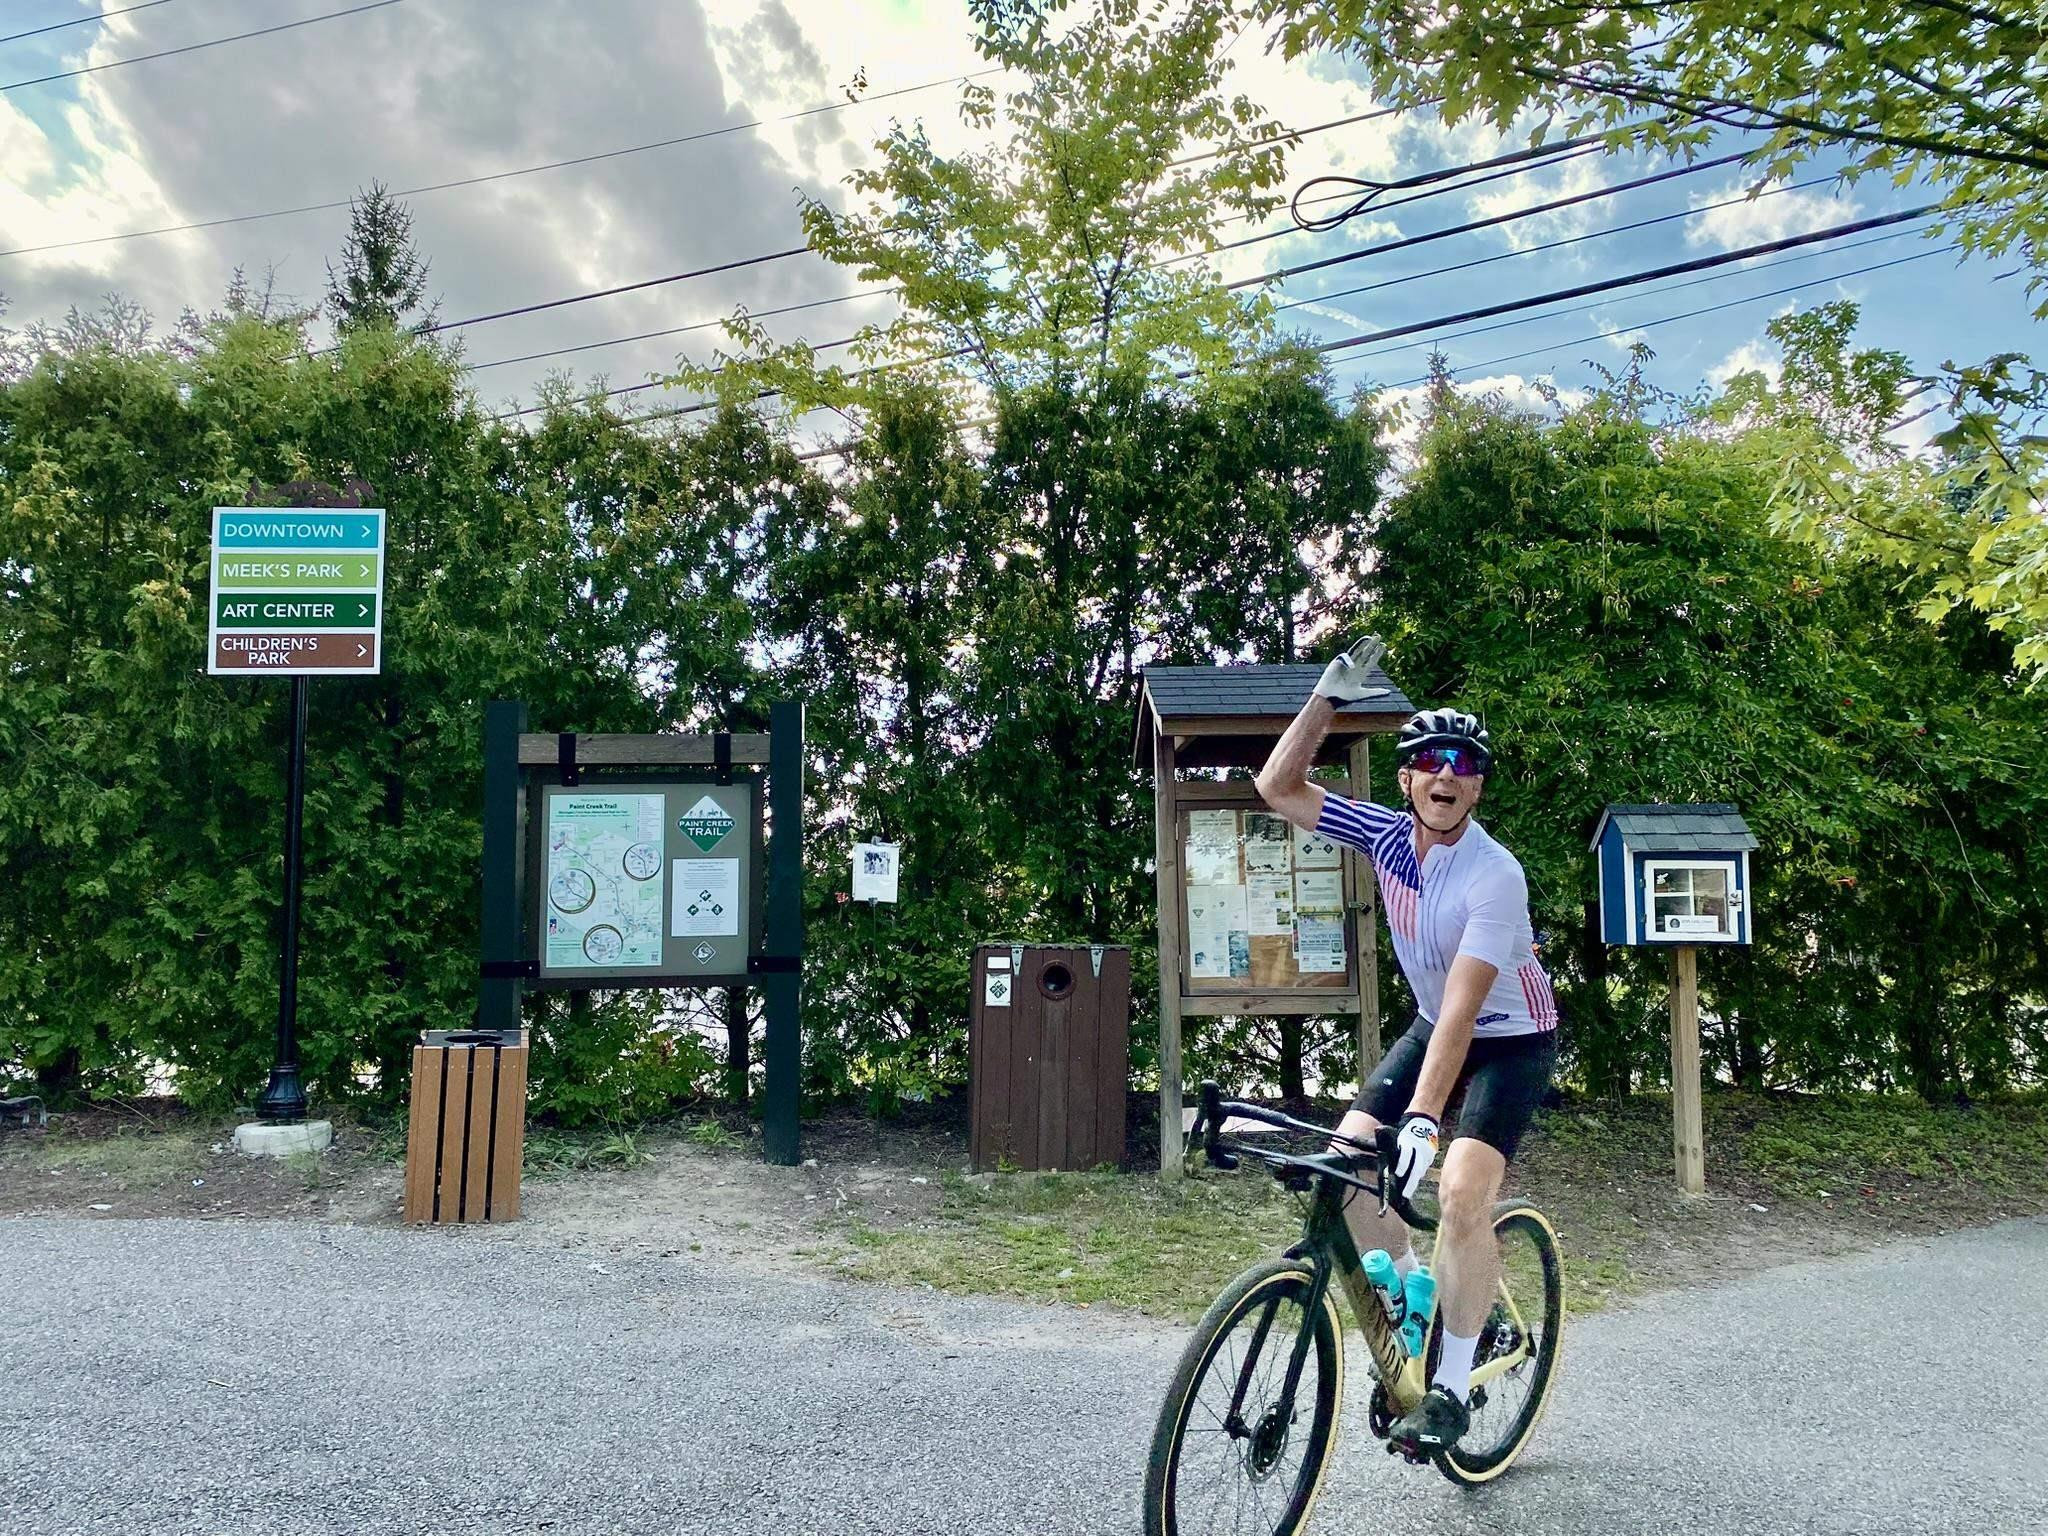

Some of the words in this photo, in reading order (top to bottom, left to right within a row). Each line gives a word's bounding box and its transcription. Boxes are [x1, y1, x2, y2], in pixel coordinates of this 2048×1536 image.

[223, 524, 344, 538] DOWNTOWN
[222, 563, 291, 578] MEEK'S
[296, 563, 344, 578] PARK
[222, 603, 259, 618] ART
[263, 603, 335, 618] CENTER
[220, 637, 318, 651] CHILDREN'S
[247, 652, 291, 665] PARK
[687, 827, 724, 836] TRAIL
